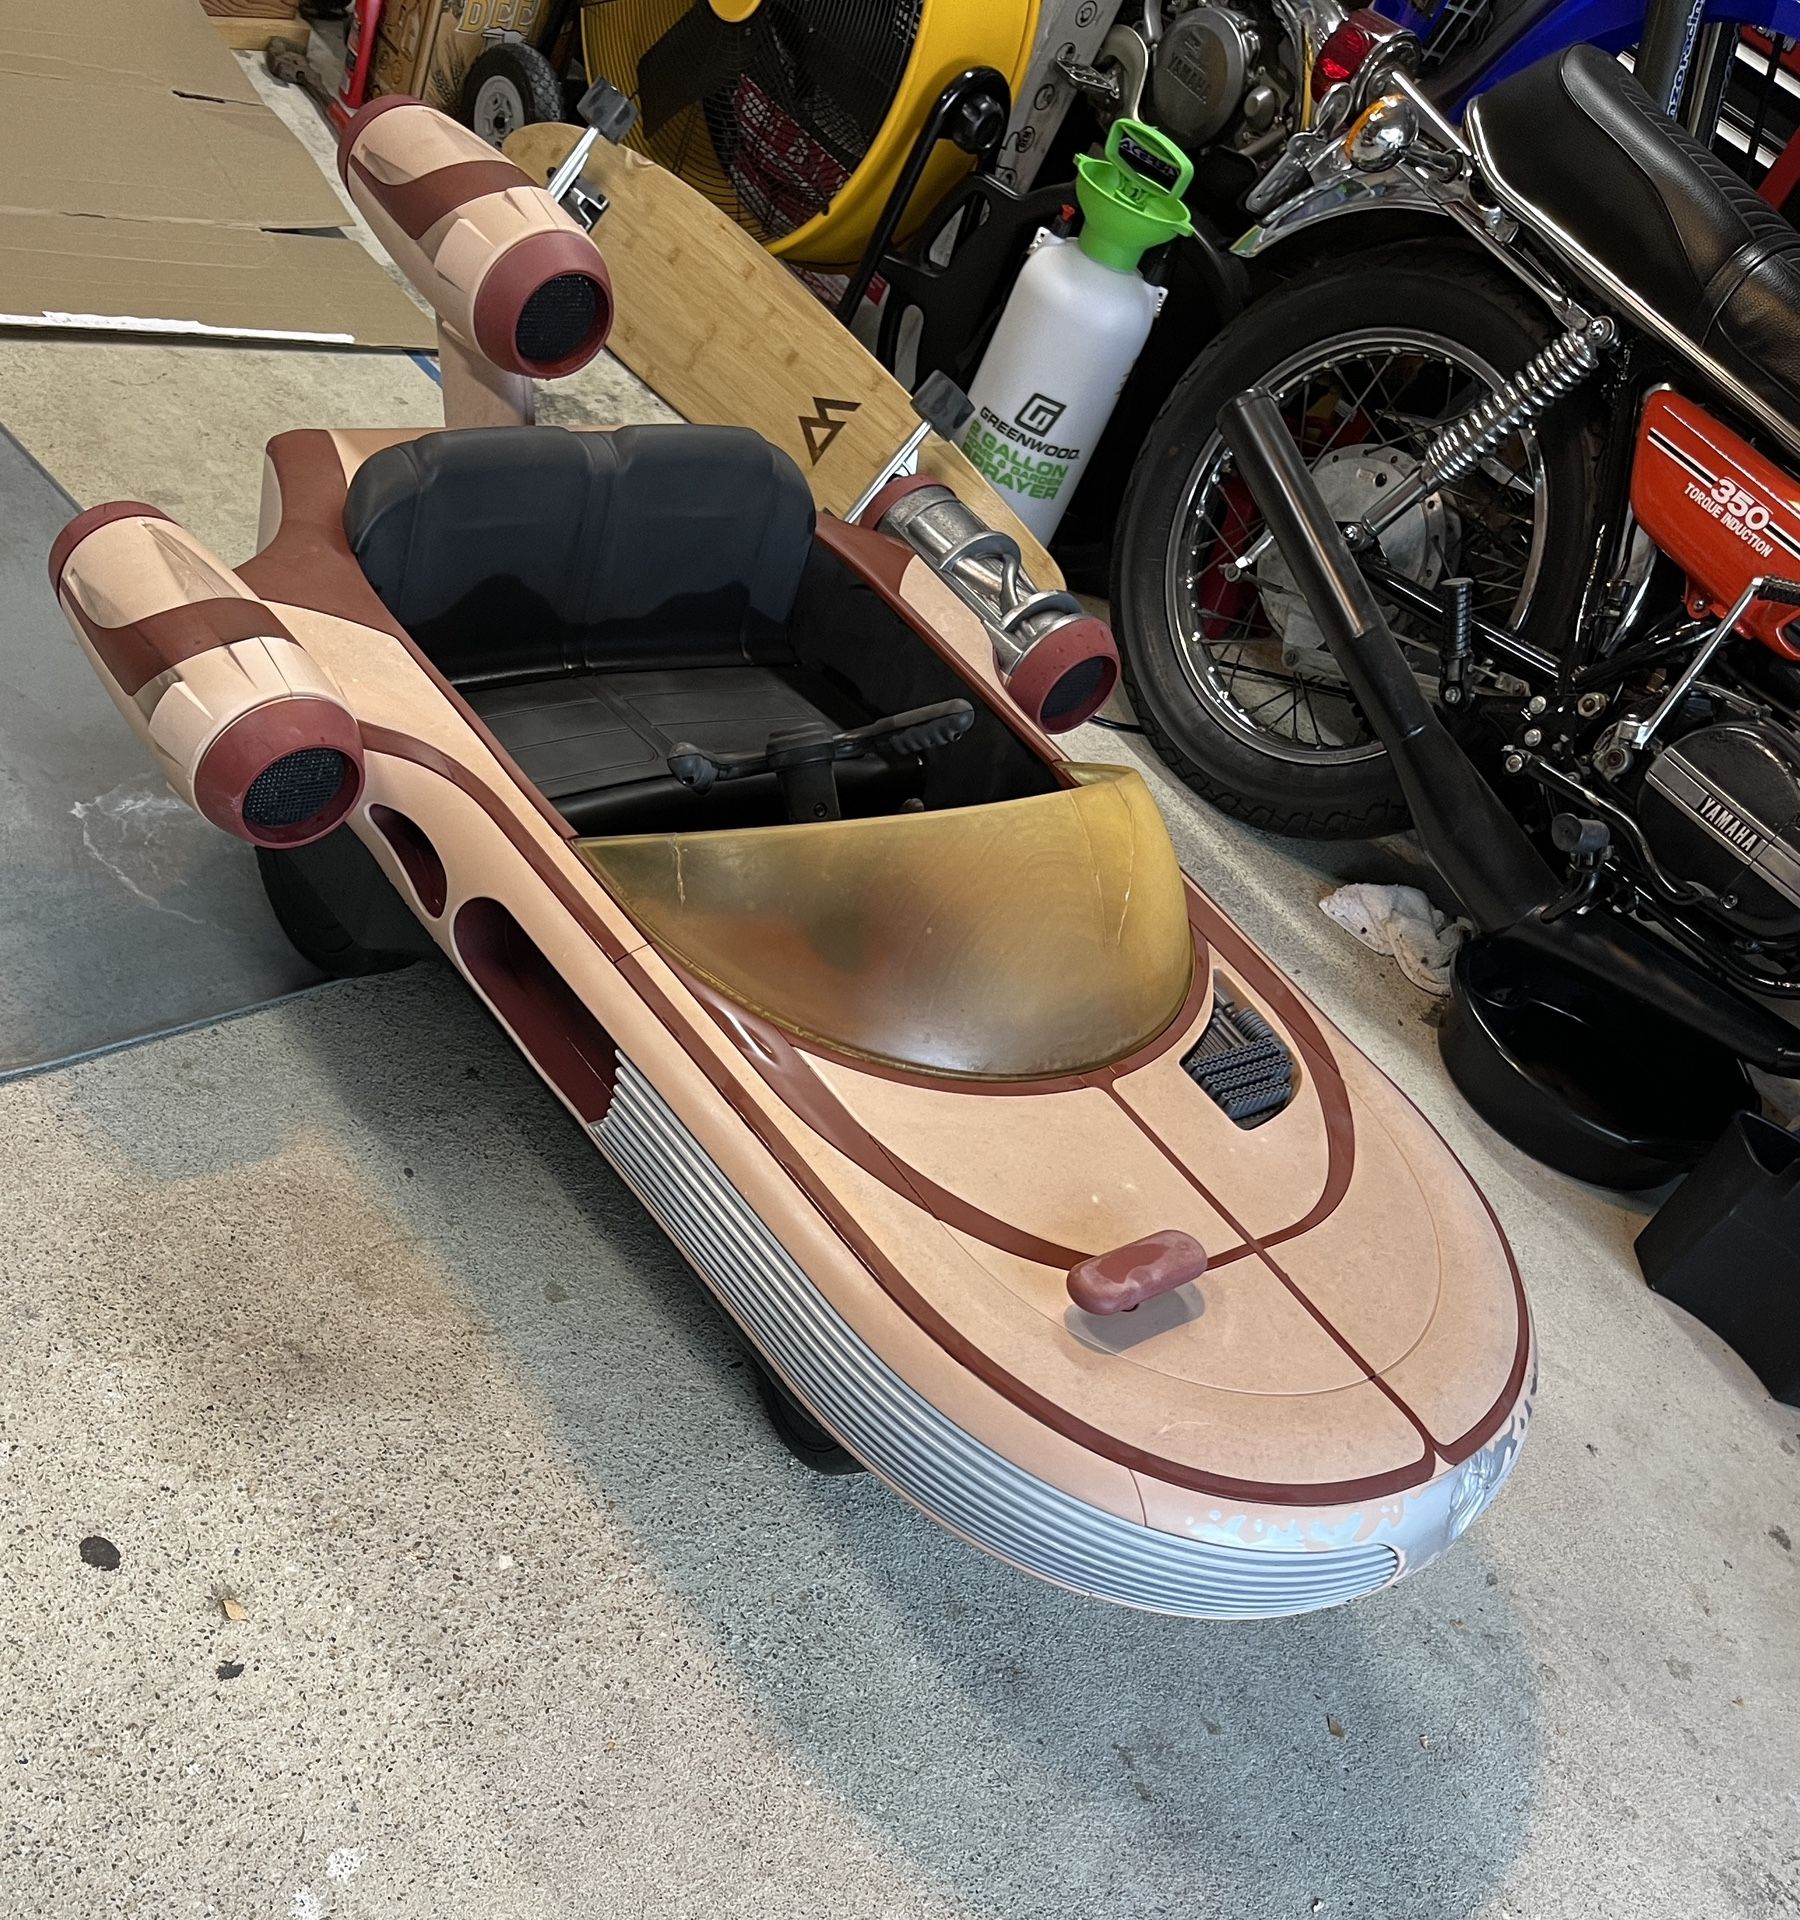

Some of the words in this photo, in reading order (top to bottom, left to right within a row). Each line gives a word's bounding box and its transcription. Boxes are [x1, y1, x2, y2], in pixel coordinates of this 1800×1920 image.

[980, 406, 1080, 460] GREENWOOD
[981, 432, 1069, 479] GALLON
[1010, 466, 1064, 487] GARDEN
[1683, 481, 1725, 519] TORQUE
[1719, 511, 1774, 558] INDUCTION
[1710, 478, 1770, 531] 350
[1699, 796, 1759, 852] YAMAHA
